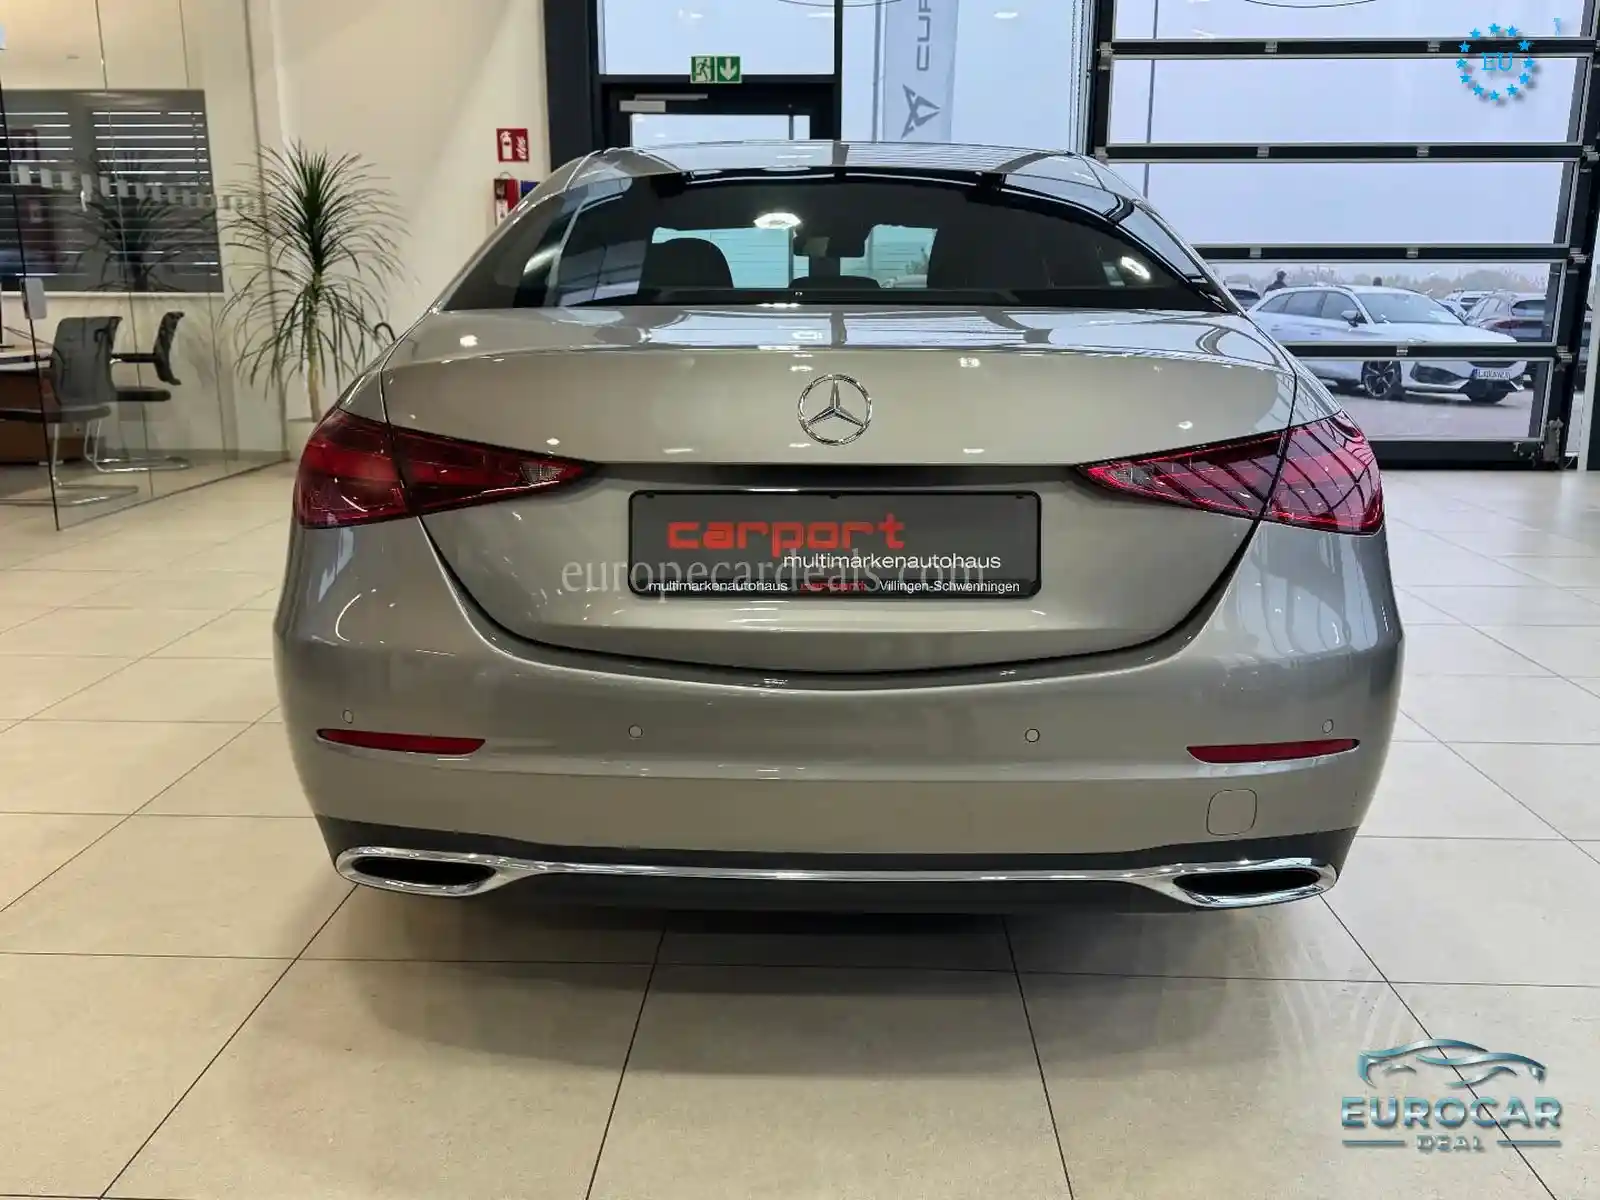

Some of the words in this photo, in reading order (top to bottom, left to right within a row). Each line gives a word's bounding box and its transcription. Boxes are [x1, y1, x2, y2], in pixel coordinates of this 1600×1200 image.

[667, 513, 905, 558] carport
[783, 551, 1001, 570] multimarkenautohaus
[648, 579, 789, 593] multimarkenautohaus
[879, 579, 1021, 595] Villingen-Schwenningen
